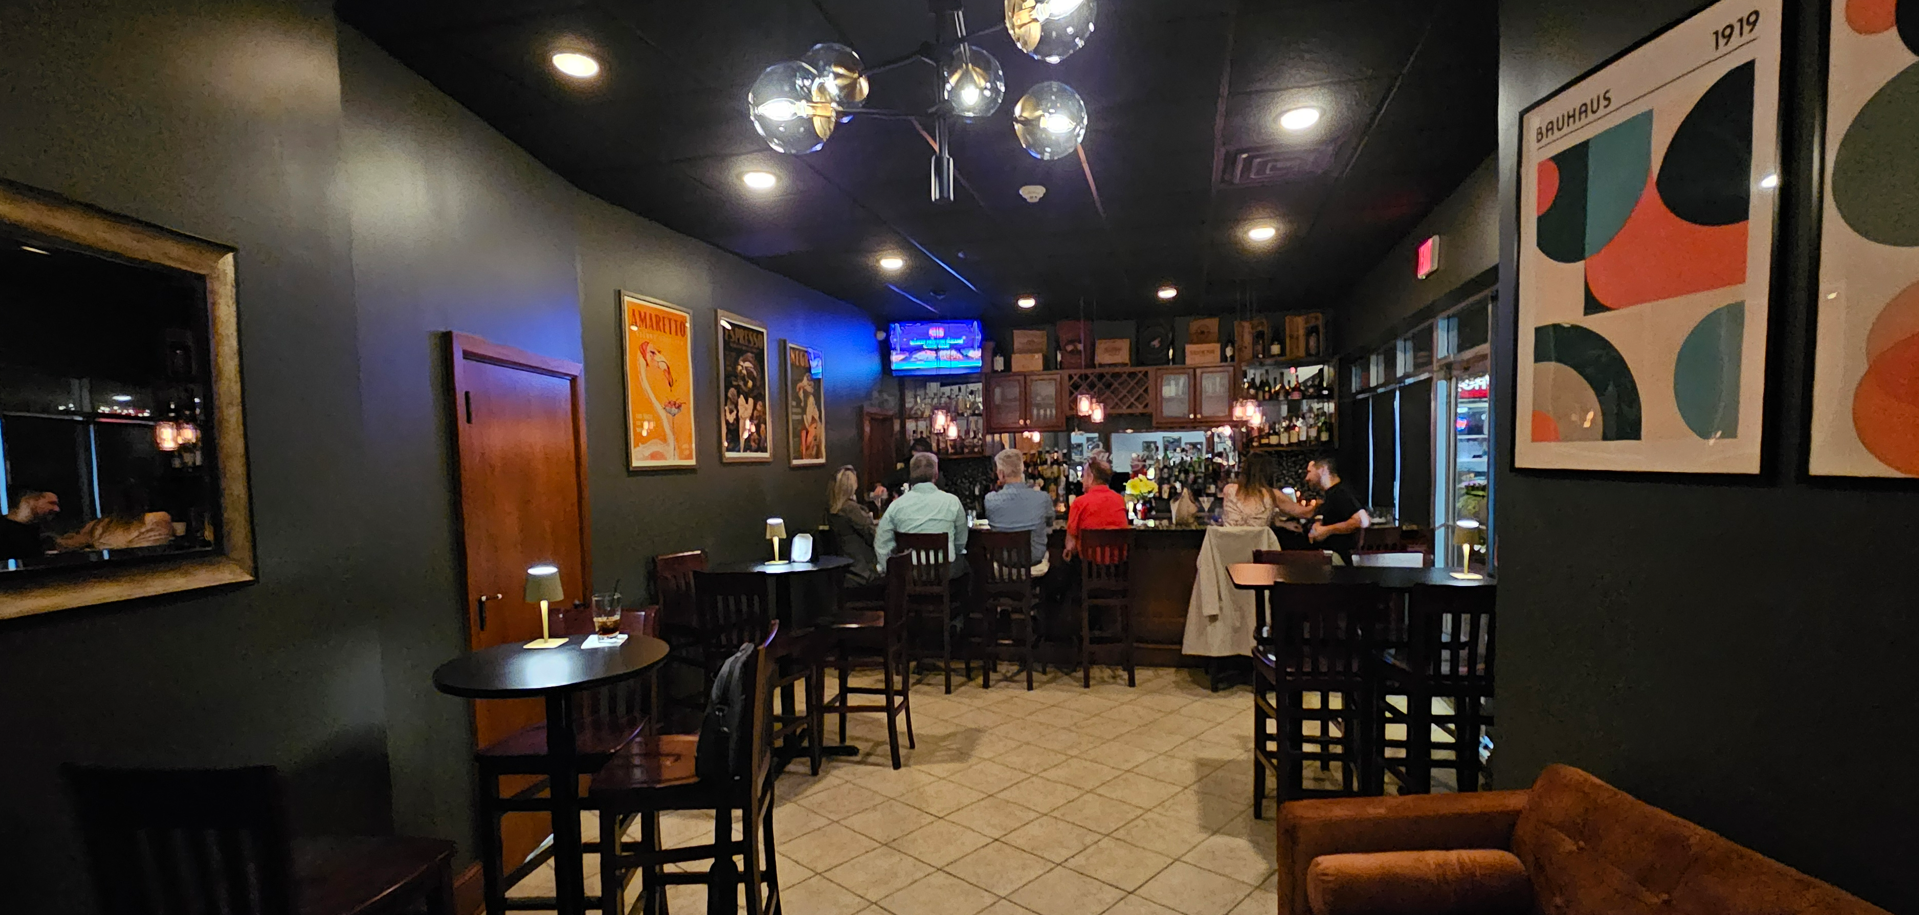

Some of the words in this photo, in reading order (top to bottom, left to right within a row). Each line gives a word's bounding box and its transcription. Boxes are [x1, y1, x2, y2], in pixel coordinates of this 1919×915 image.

[1712, 9, 1760, 51] 1919
[1535, 89, 1612, 143] BAUHAUS
[631, 308, 686, 338] AMARETTO
[724, 327, 764, 349] ESPRESSO
